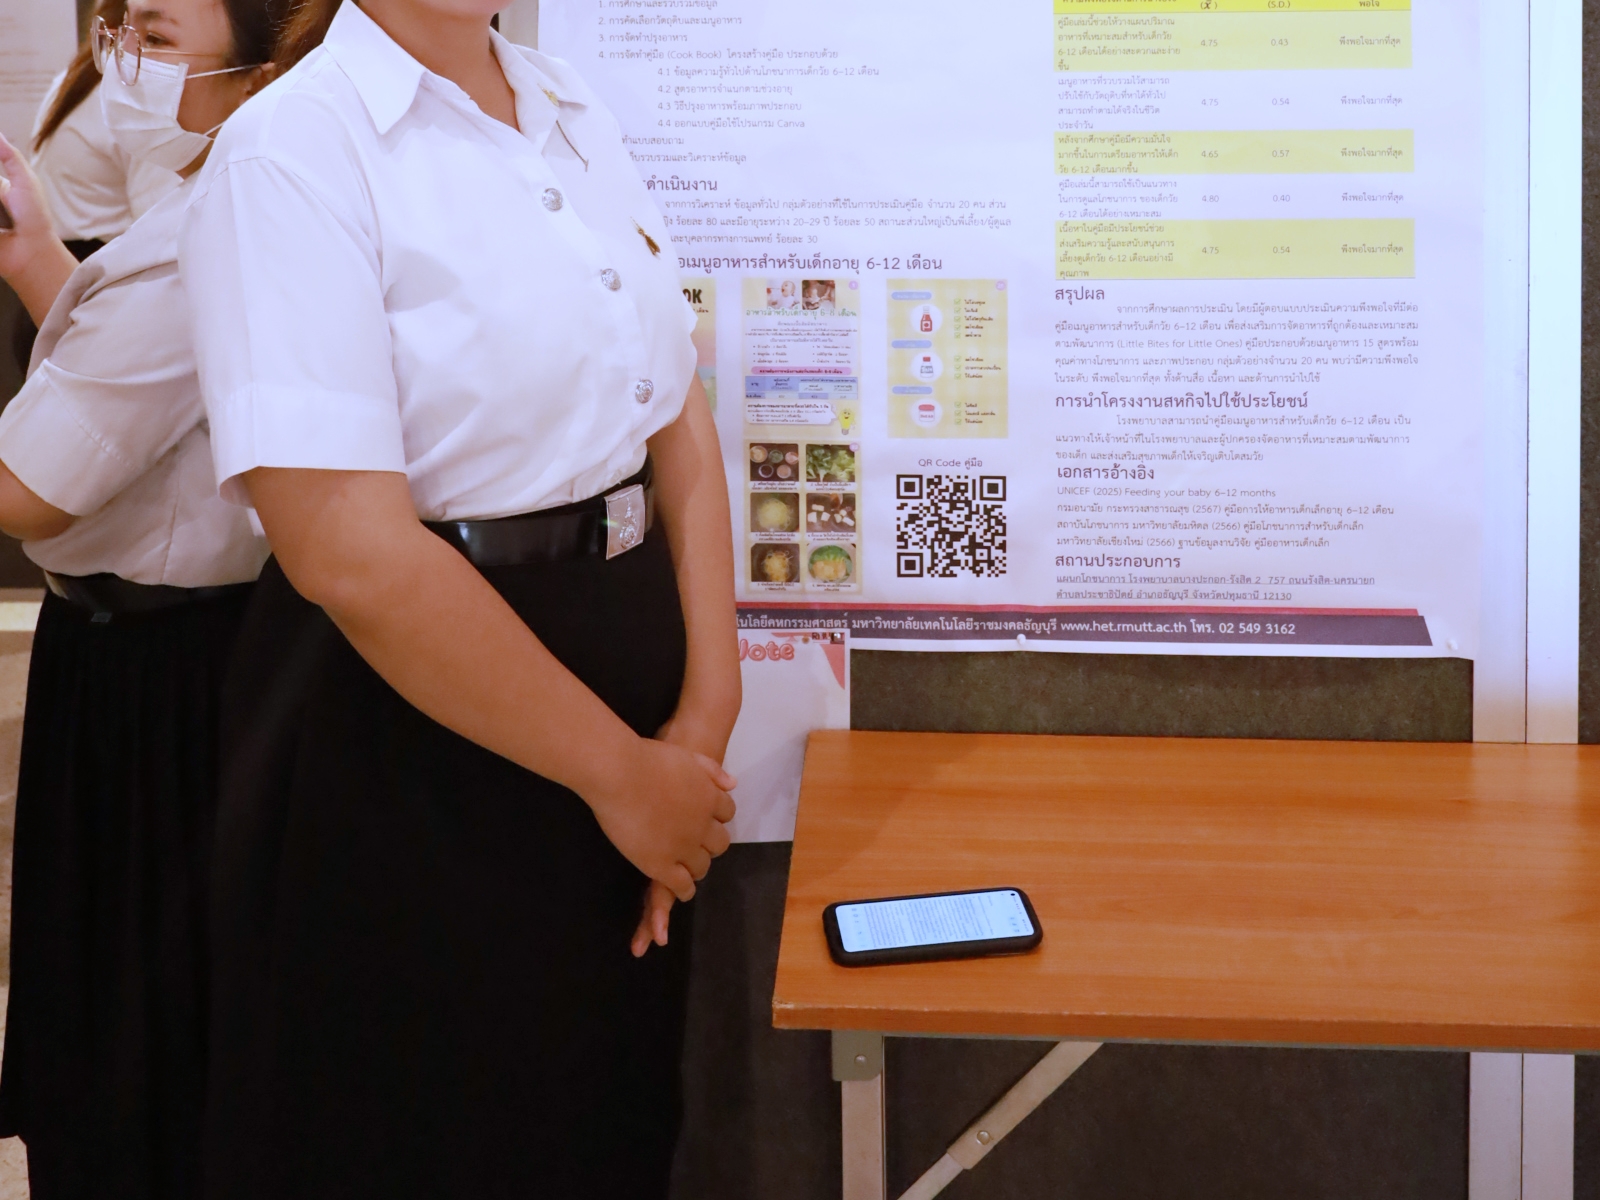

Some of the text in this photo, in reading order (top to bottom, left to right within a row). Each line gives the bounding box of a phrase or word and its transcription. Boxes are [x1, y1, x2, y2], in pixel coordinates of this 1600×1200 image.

[599, 0, 605, 8] 1.
[610, 49, 664, 62] การจัดทำคู่มือ
[667, 50, 693, 59] (Cook
[696, 50, 721, 59] Book)
[727, 48, 783, 61] โครงสร้างคู่มือ
[787, 48, 838, 58] ประกอบด้วย
[658, 68, 669, 76] 4.1
[858, 65, 879, 75] เดือน
[1201, 150, 1289, 158] 4.65 0.57
[867, 257, 900, 269] 6-12
[907, 254, 942, 269] เดือน
[1055, 286, 1104, 305] สรุปผล
[1055, 337, 1418, 351] ตามพัฒนาการ (Little Bites for Little Ones) คู่มือประกอบด้วยเมนูอาหาร 15 สูตรพร้อม
[1056, 391, 1307, 408] การนำโครงงานสหกิจไปใช้ประโยชน์
[918, 457, 982, 470] QR Code คู่มือ
[1058, 462, 1154, 479] เอกสารอ้างอิง
[1057, 487, 1090, 495] UNICEF
[1093, 487, 1122, 496] (2025)
[1125, 488, 1160, 498] Feeding
[1164, 490, 1185, 498] your
[1188, 488, 1211, 498] baby
[1240, 489, 1276, 497] months
[1057, 503, 1102, 512] กรมอนามัย
[1107, 506, 1189, 515] กระทรวงสาธารณสุข
[1193, 505, 1221, 513] (2567)
[1224, 504, 1342, 517] คู่มือการให้อาหารเด็กเล็กอายุ
[1372, 505, 1394, 514] เดือน
[1055, 553, 1180, 568] สถานประกอบการ
[850, 616, 1056, 635] มหาวิทยาลัยเทคโนโลยีราชมงคลธัญบุรี
[1061, 621, 1187, 632] www.het.rmutt.ac.th
[1190, 619, 1214, 633] โทร.
[1219, 623, 1234, 633] 02
[1239, 623, 1261, 633] 549
[1266, 624, 1295, 634] 3162
